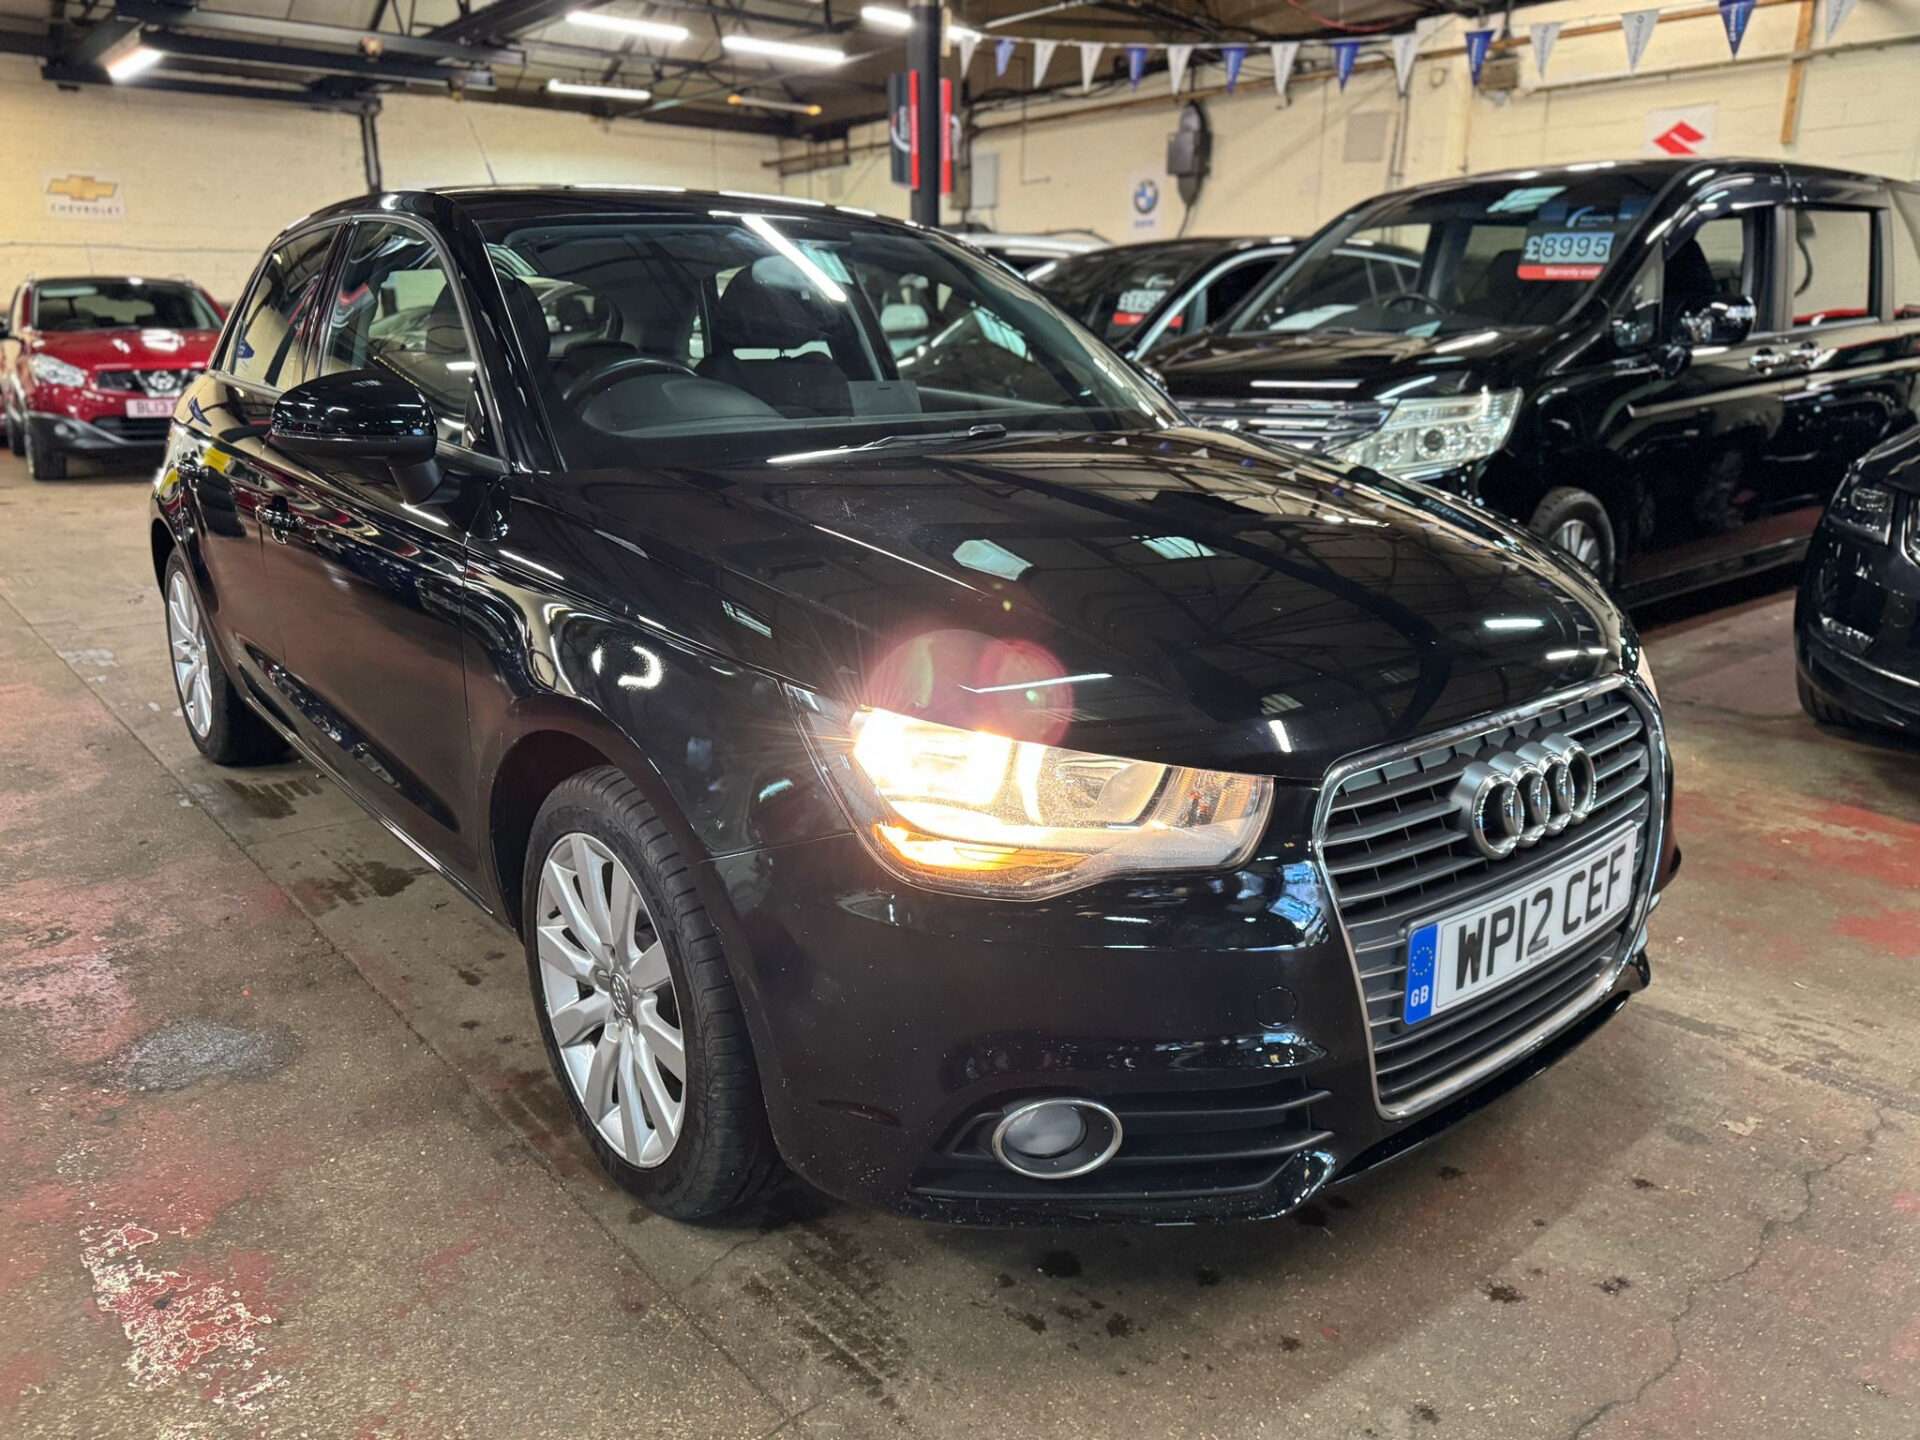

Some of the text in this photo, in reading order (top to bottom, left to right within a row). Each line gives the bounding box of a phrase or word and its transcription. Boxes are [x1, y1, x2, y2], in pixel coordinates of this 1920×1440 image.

[50, 203, 120, 215] CHEVROLET
[1523, 235, 1609, 260] £8995
[1455, 843, 1627, 991] WP12 CEF
[1410, 984, 1430, 1008] GB
